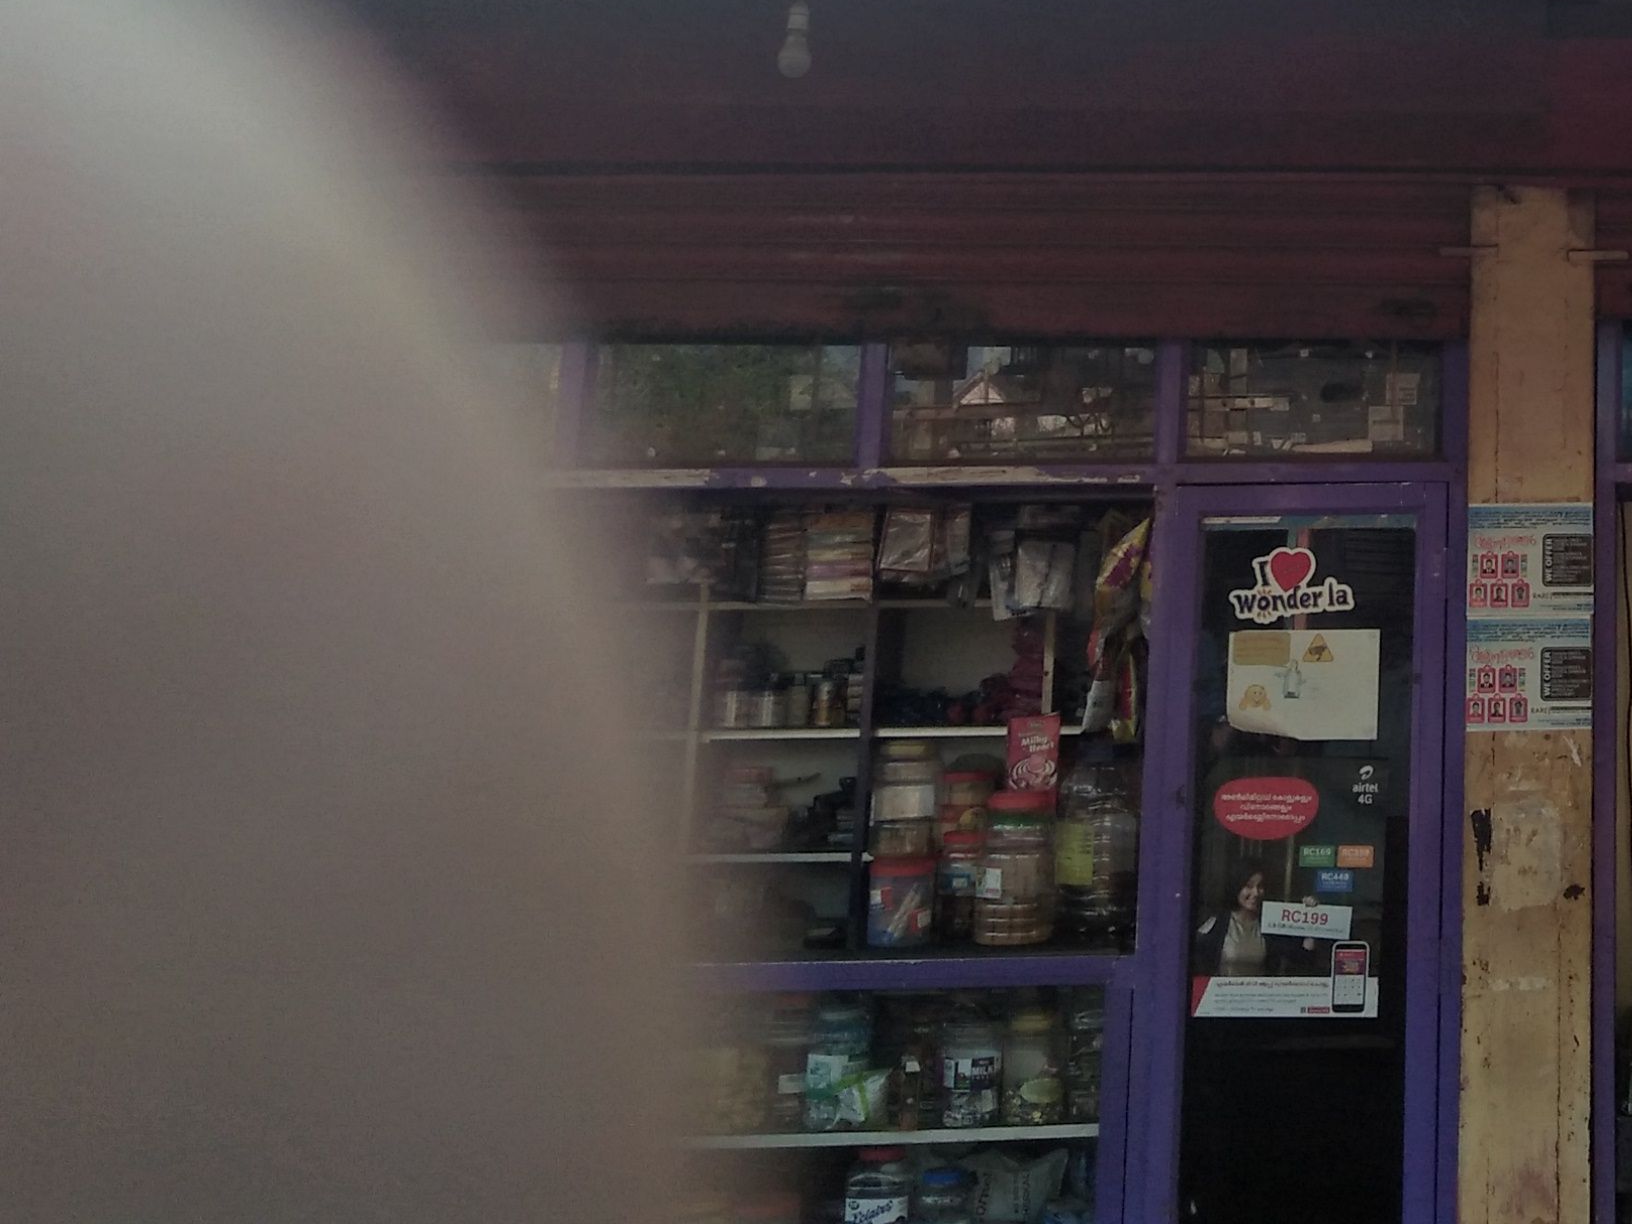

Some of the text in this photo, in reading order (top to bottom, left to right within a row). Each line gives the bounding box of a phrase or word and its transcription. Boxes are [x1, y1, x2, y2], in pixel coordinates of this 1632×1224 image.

[1257, 560, 1270, 587] I
[1352, 782, 1379, 793] airtel
[1356, 794, 1374, 805] 4G
[1281, 908, 1329, 926] RC199
